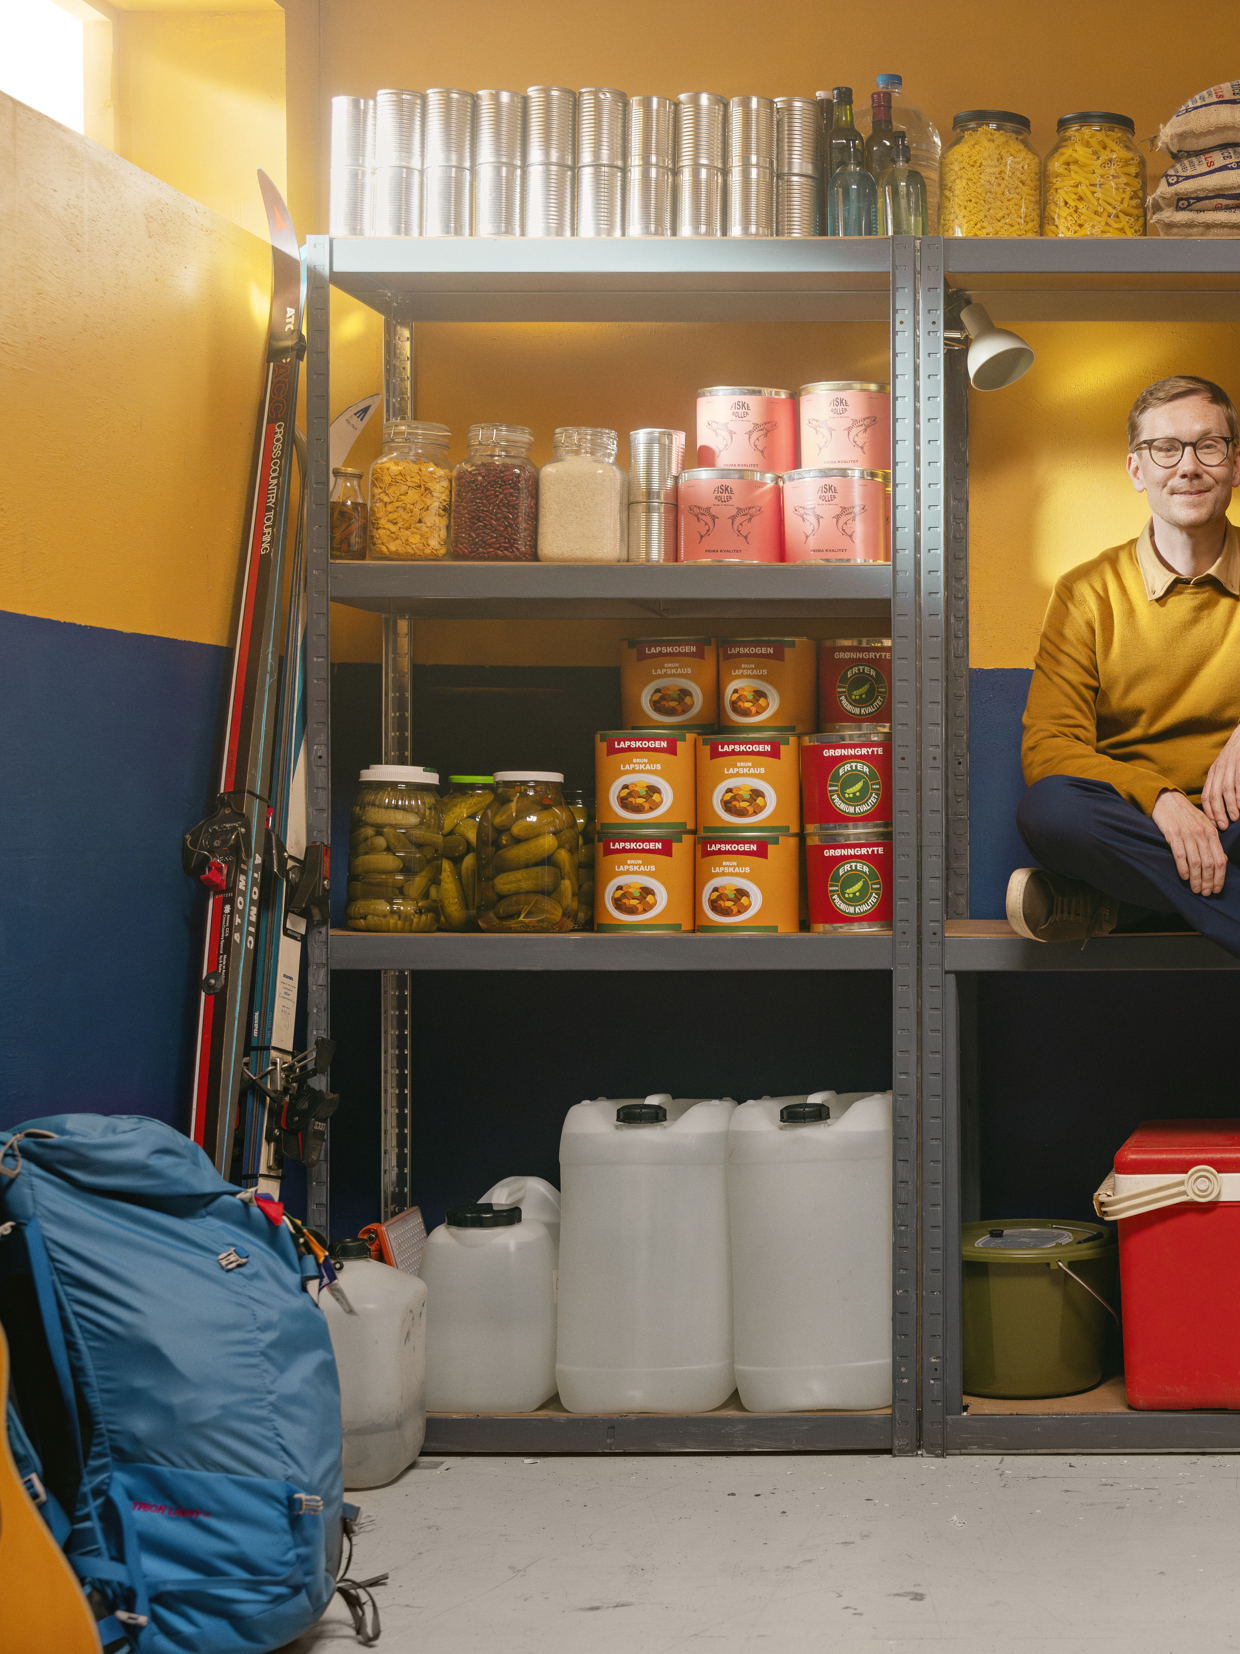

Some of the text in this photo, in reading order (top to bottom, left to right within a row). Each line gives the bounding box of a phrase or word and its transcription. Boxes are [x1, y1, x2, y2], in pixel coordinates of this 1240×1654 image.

[730, 401, 751, 410] FISKE
[829, 397, 849, 407] FISKE
[260, 422, 284, 554] CROSS COUNTRY TOURING
[713, 484, 735, 494] FISKE
[817, 484, 838, 494] FISKE
[646, 646, 696, 654] LAPSKOGEN
[848, 666, 876, 678] ERTER
[840, 696, 884, 714] PREMIUM KVALITET
[718, 744, 770, 752] LAPSKOGEN
[823, 748, 884, 756] GRØNNGRYTE
[839, 763, 869, 776] ERTER
[832, 792, 878, 813] PREMIUM KVALITET
[610, 842, 662, 850] LAPSKOGEN
[824, 847, 884, 856] GRØNNGRYTE
[839, 863, 869, 876] ERTER
[234, 864, 248, 944] ATOMI
[247, 854, 262, 950] ATOMIC
[832, 892, 878, 914] PREMIUM KVALITET
